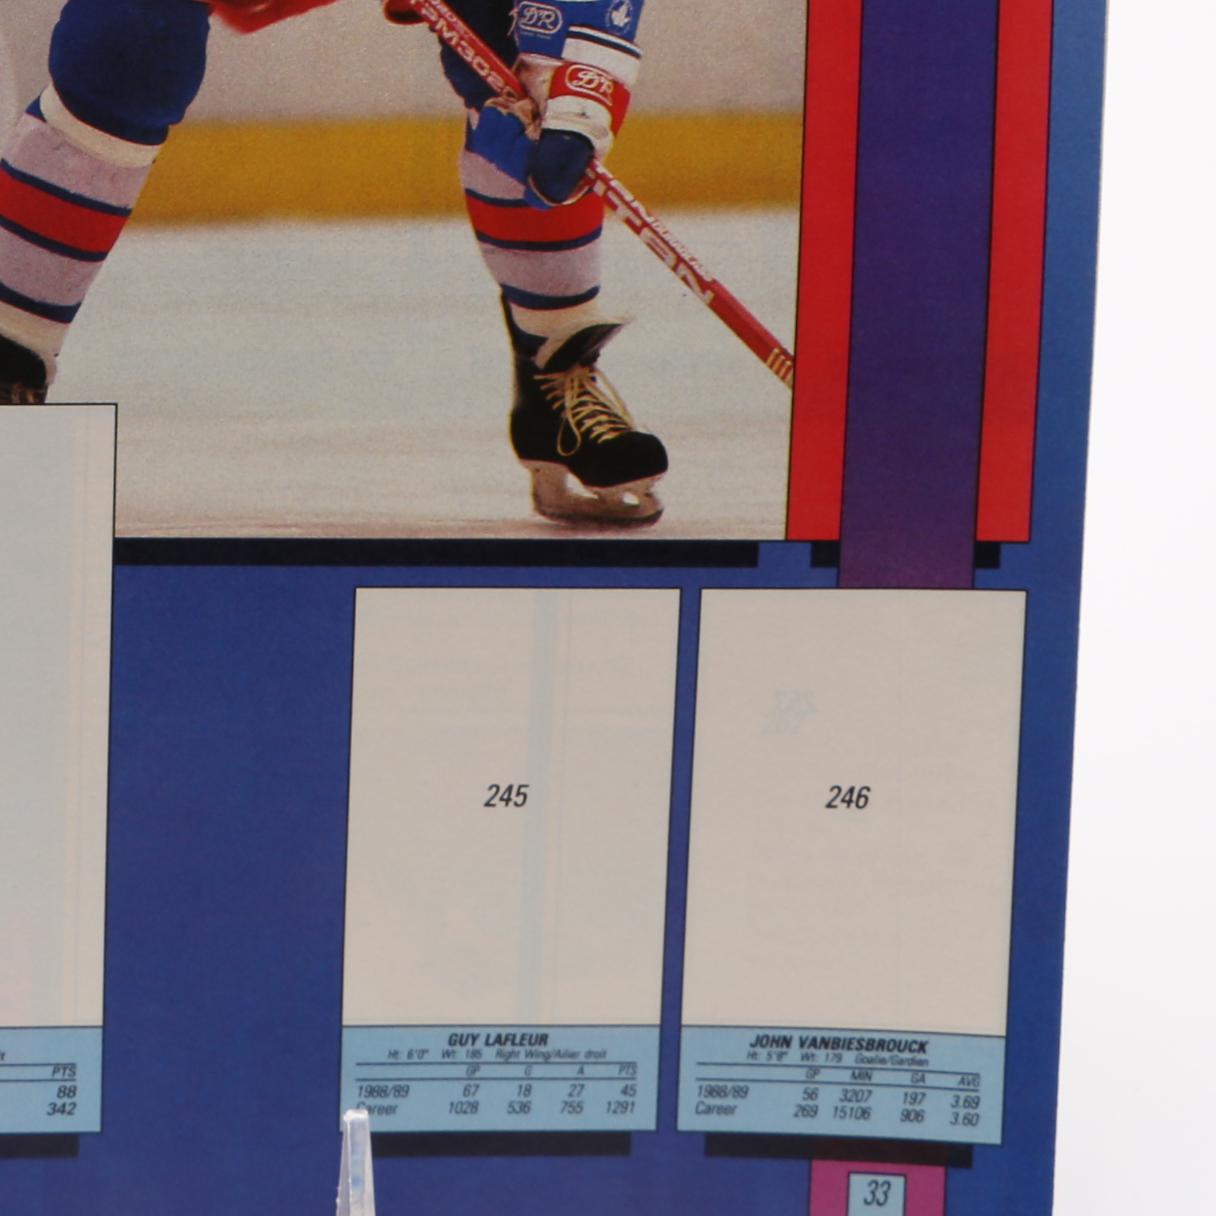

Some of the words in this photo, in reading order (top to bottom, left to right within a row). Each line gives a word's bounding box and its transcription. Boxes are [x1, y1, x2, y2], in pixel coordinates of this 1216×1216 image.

[484, 784, 529, 808] 245
[825, 785, 871, 809] 246
[448, 1034, 480, 1046] GUY
[485, 1034, 548, 1047] LAFLEUR
[750, 1035, 792, 1049] JOHN
[799, 1036, 929, 1054] VANBIESBROUCK
[357, 1085, 409, 1097] 1988/89
[463, 1084, 480, 1097] 67
[518, 1084, 531, 1097] 18
[568, 1084, 584, 1096] 27
[621, 1084, 636, 1096] 45
[697, 1085, 749, 1099] 1988/89
[803, 1087, 818, 1100] 56
[839, 1088, 872, 1102] 3207
[902, 1091, 926, 1105] 197
[951, 1094, 980, 1108] 3.69
[47, 1103, 76, 1116] 342
[864, 1180, 891, 1206] 33
